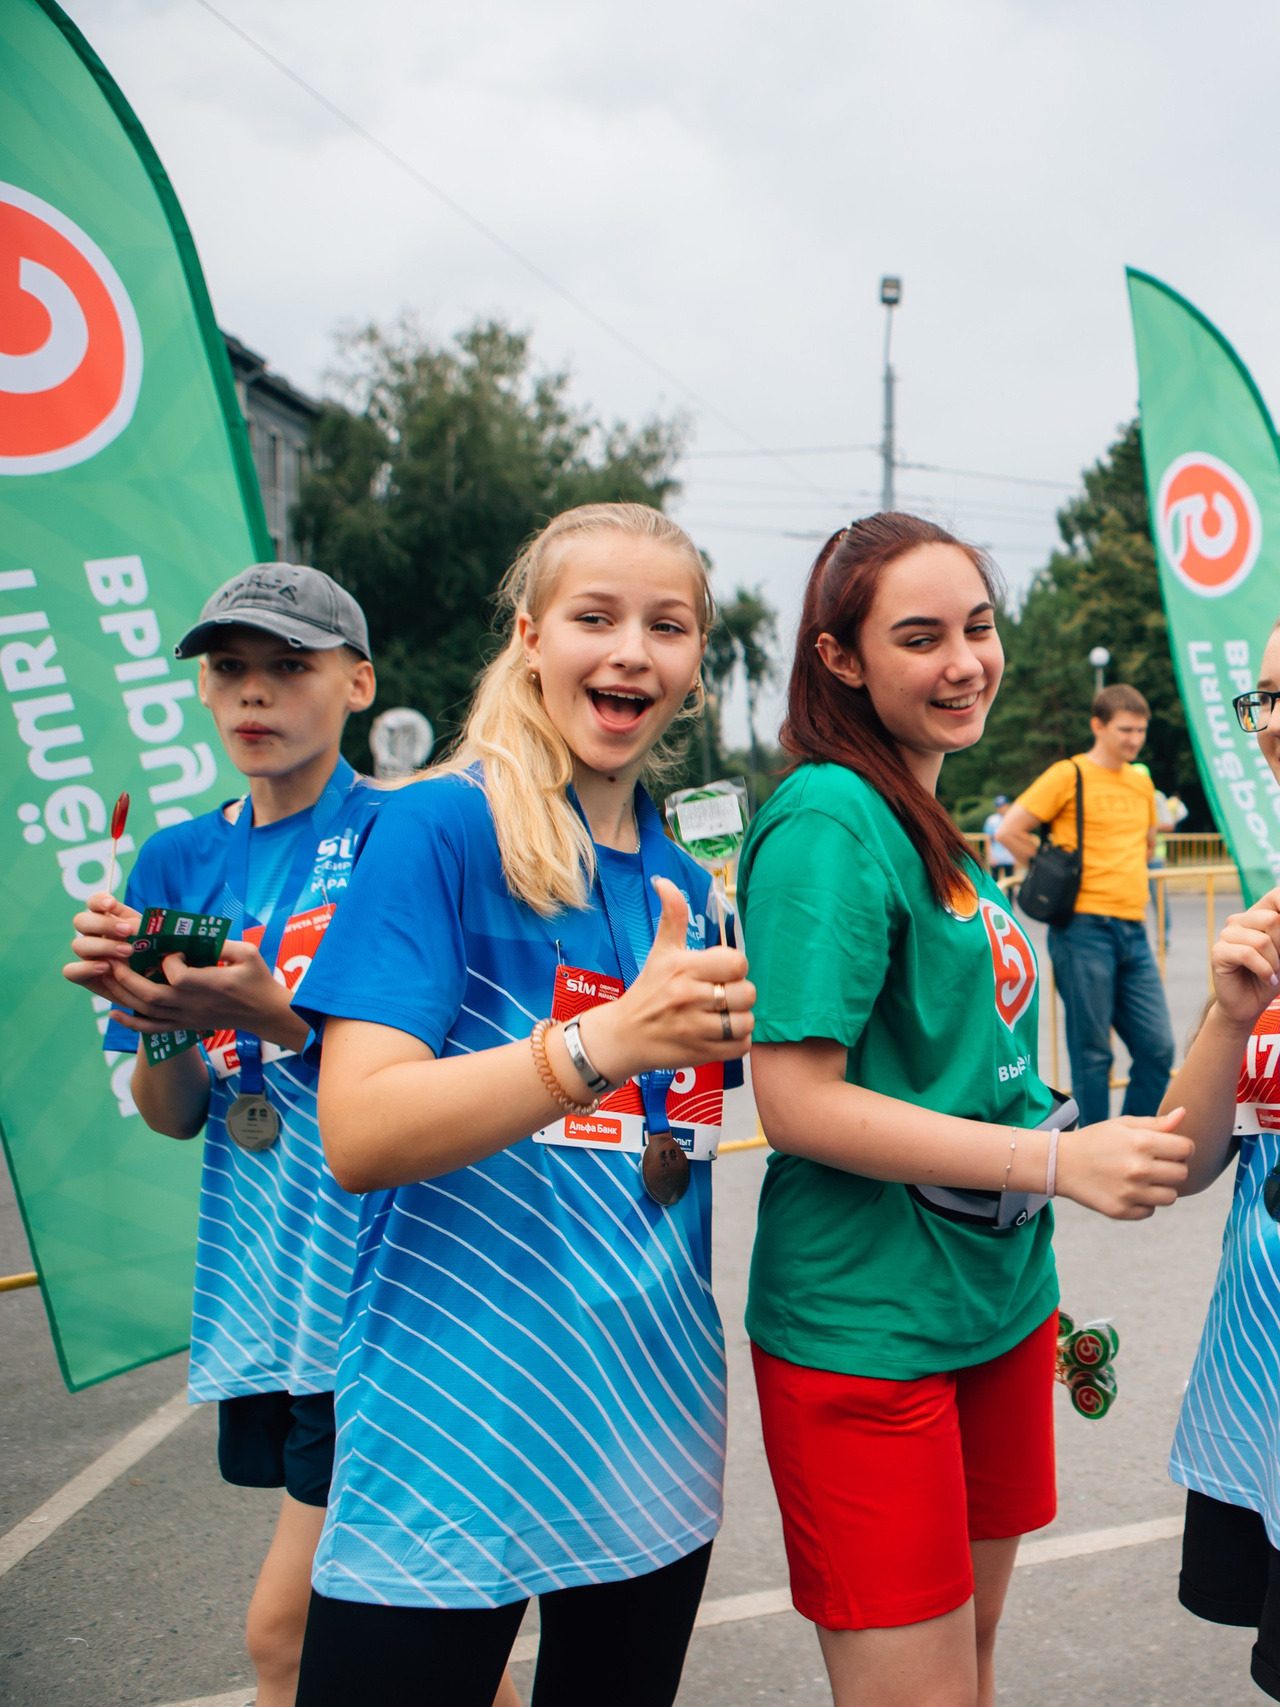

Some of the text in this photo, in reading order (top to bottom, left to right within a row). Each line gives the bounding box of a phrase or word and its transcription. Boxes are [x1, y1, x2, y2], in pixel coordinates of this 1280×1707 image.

[310, 877, 348, 893] МАРА
[569, 1121, 618, 1135] Альфа Банк
